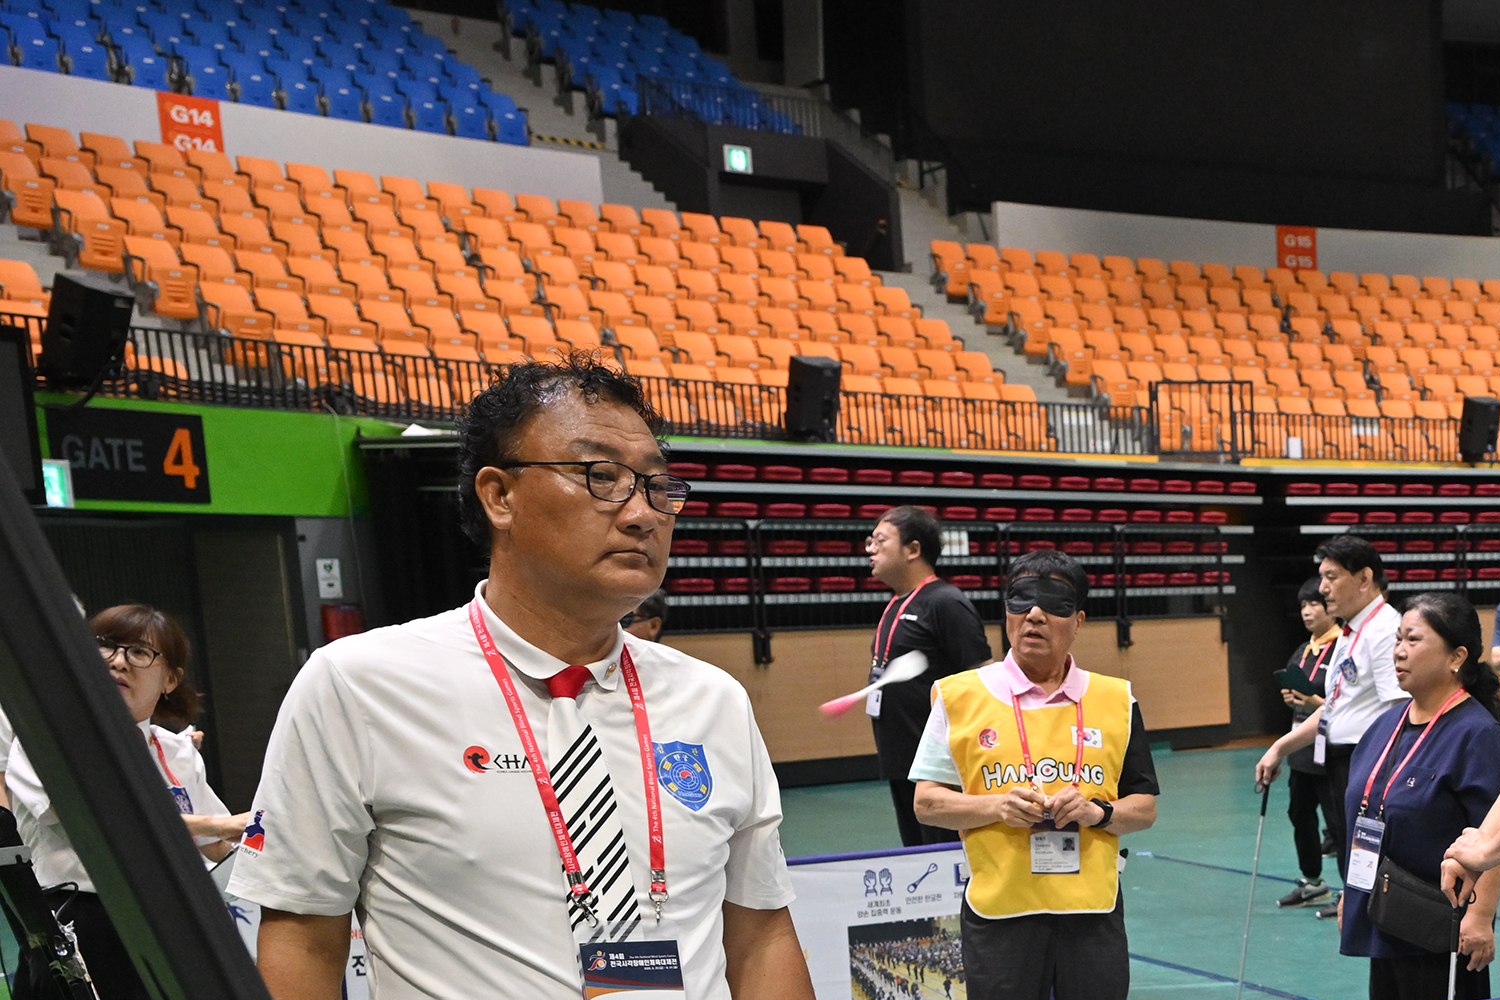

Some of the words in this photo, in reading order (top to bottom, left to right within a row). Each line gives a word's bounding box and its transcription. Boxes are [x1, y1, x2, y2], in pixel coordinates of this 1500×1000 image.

[170, 104, 214, 127] G14
[62, 434, 147, 472] GATE
[163, 428, 200, 489] 4
[501, 677, 512, 696] Games
[509, 695, 520, 714] Sports
[516, 714, 525, 729] Blind
[521, 728, 534, 753] National
[534, 763, 542, 774] The
[981, 757, 1104, 790] HANGUNG
[648, 786, 656, 809] National
[610, 958, 678, 967] 전국시각장애인체육대제전
